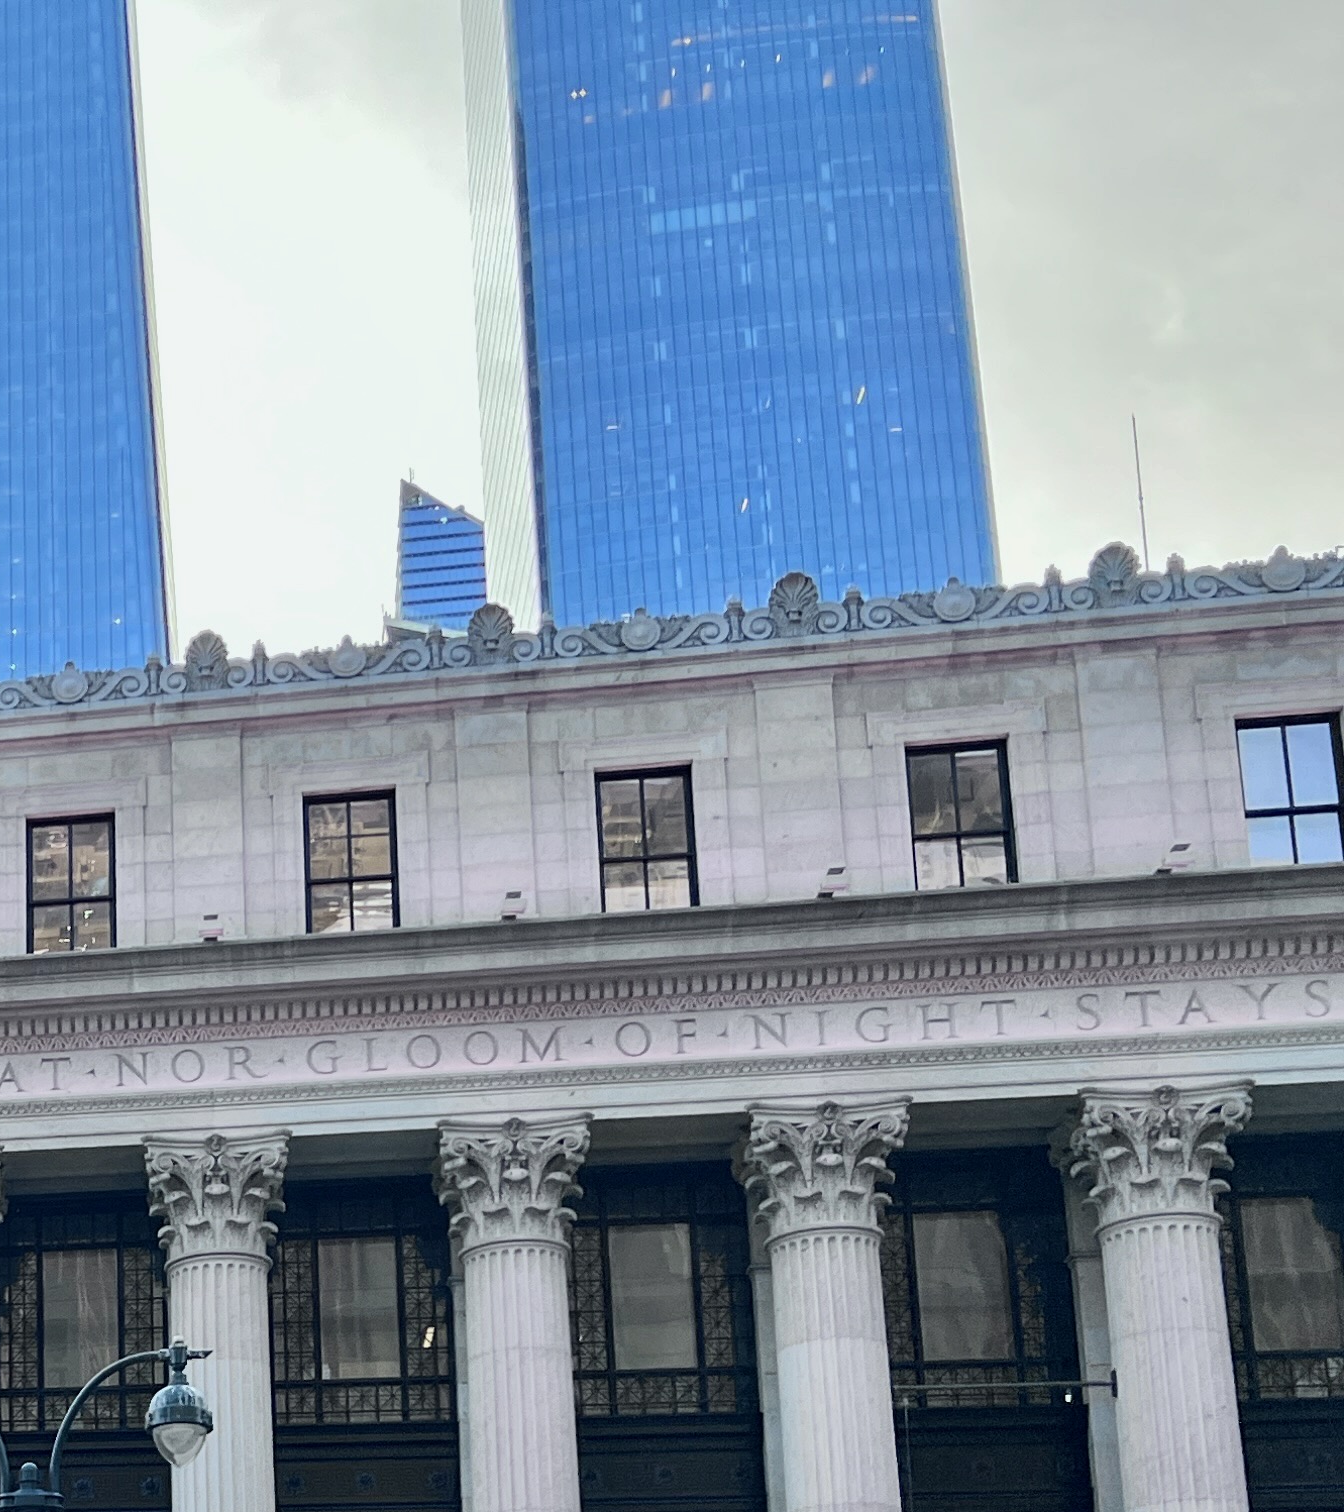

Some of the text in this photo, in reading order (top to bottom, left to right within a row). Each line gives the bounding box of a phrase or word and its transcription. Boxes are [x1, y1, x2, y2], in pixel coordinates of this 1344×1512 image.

[113, 1046, 269, 1087] NOR
[305, 1025, 569, 1075] GLOOM
[614, 1018, 699, 1058] OF
[744, 998, 1018, 1051] NIGHT
[1073, 978, 1334, 1032] STAYS
